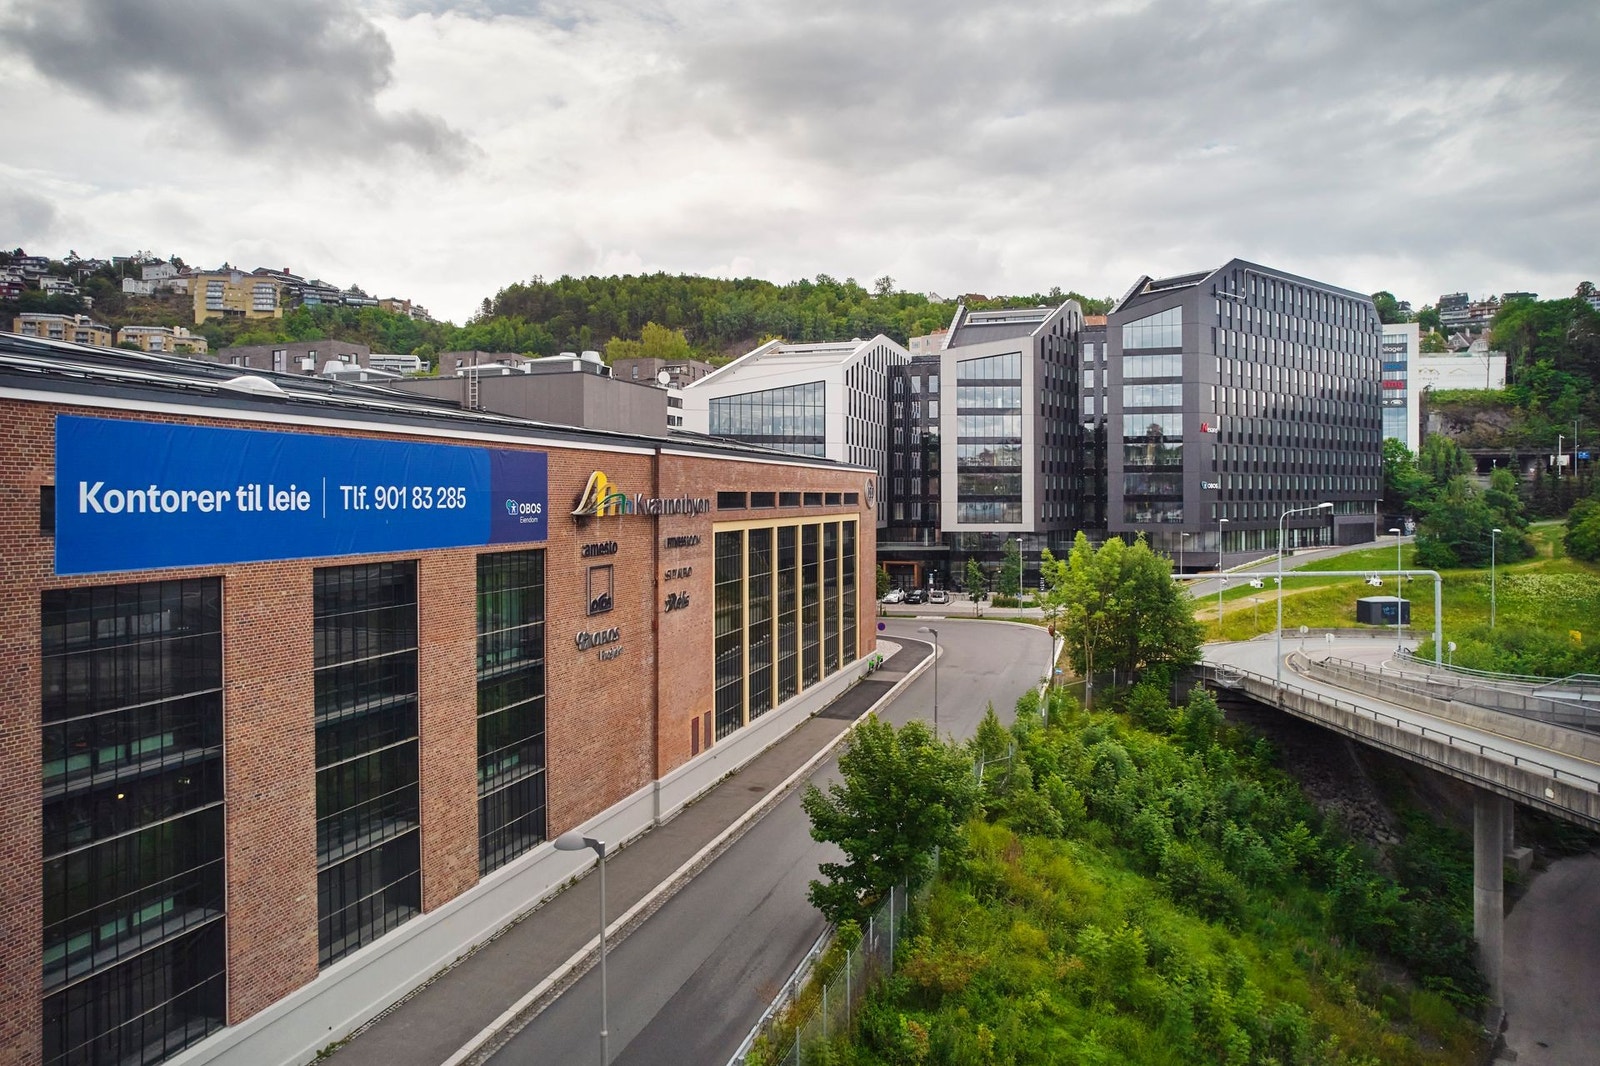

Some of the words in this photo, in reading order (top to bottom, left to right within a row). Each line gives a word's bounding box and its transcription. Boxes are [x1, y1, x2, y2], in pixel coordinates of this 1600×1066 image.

[79, 481, 231, 514] Kontorer
[236, 483, 263, 512] til
[268, 484, 311, 511] leie
[340, 485, 370, 510] Tlf.
[374, 485, 407, 510] 901
[412, 486, 433, 510] 83
[437, 486, 467, 509] 285
[519, 503, 542, 514] OBOS
[582, 541, 618, 557] amesto
